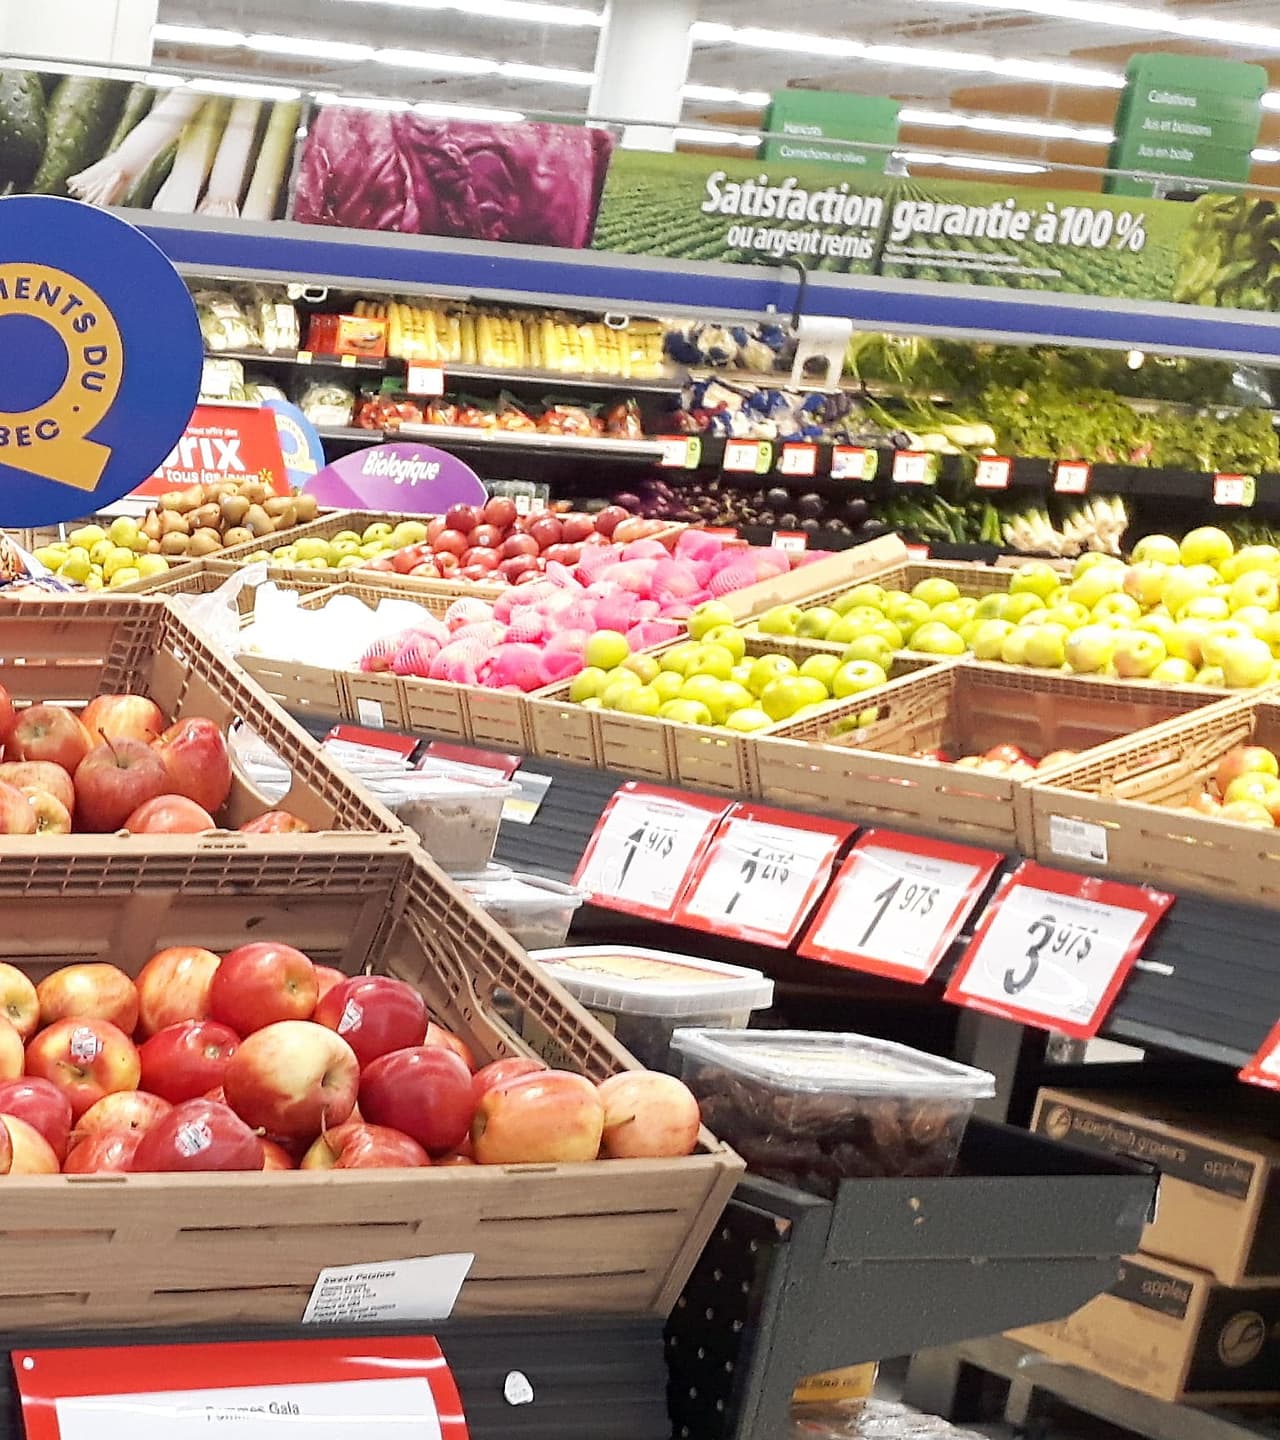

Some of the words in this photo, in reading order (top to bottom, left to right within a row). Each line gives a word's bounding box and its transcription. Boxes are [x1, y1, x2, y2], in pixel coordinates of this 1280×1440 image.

[701, 170, 883, 228] Satisfaction
[1035, 201, 1058, 244] à
[1058, 206, 1114, 249] 100
[727, 225, 753, 248] ou
[754, 228, 820, 258] argent
[821, 230, 875, 260] remis
[81, 345, 108, 393] DU
[361, 450, 440, 486] Biologique
[269, 1400, 301, 1416] Gala
